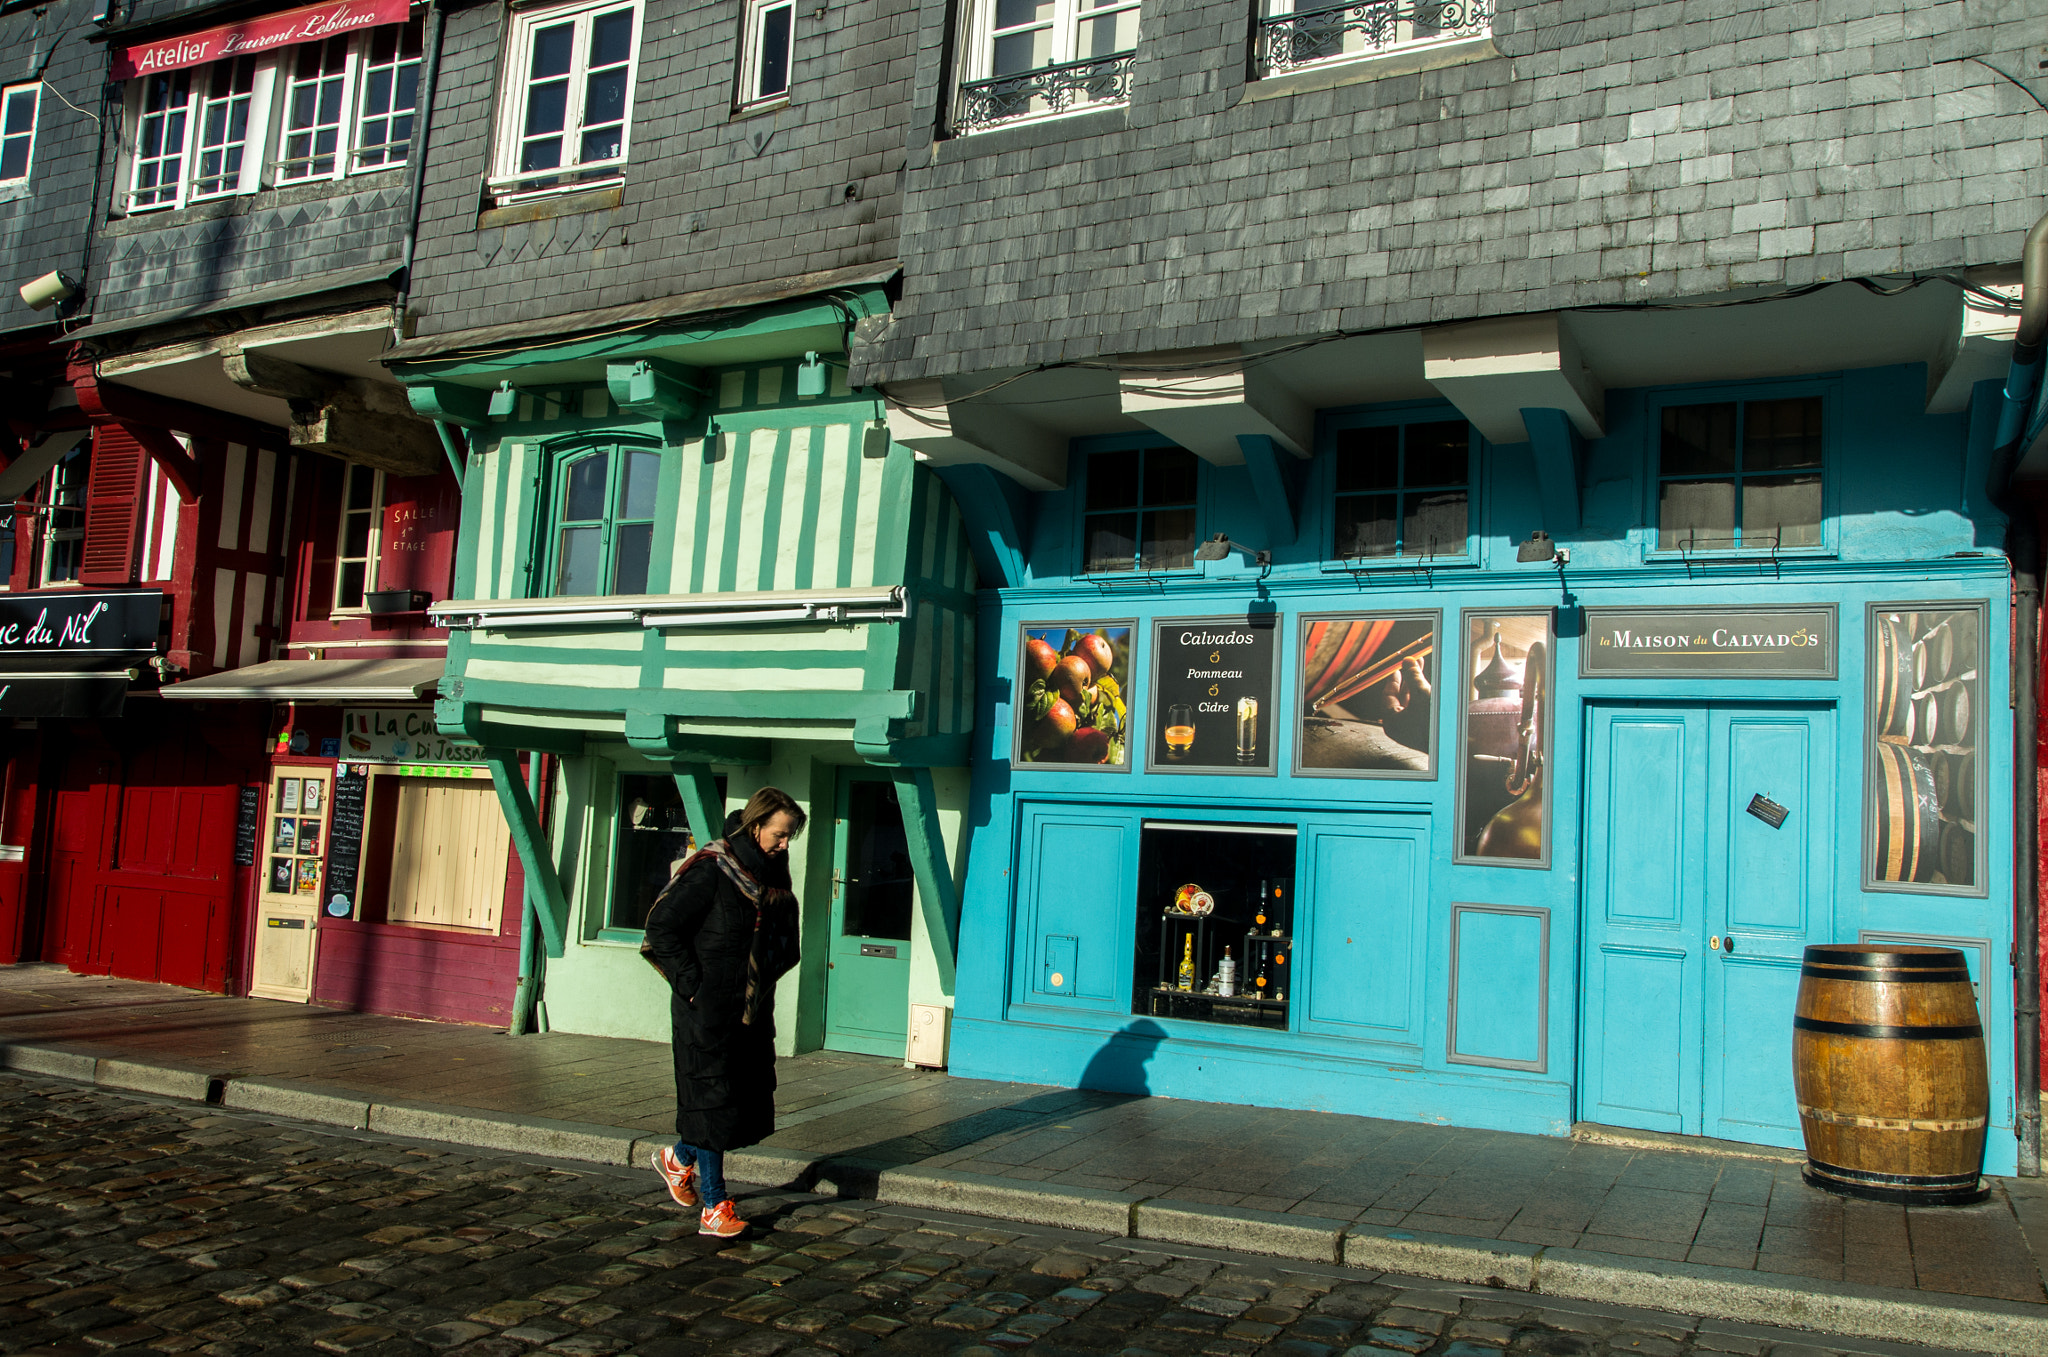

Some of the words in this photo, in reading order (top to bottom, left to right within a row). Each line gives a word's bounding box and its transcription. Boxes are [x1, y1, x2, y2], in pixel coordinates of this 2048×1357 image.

[139, 39, 209, 71] Atelier
[218, 24, 298, 55] Laurent
[297, 3, 375, 38] Leblanc
[394, 507, 435, 523] SALLE
[393, 541, 426, 551] ETAGE
[25, 607, 54, 645] du
[1180, 630, 1254, 646] Calvados
[1599, 635, 1610, 646] la
[1693, 635, 1708, 645] du
[1186, 668, 1243, 679] Pommeau
[1198, 702, 1230, 713] Cidre
[374, 711, 398, 736] La
[415, 741, 430, 759] Di
[381, 754, 399, 763] Rapide
